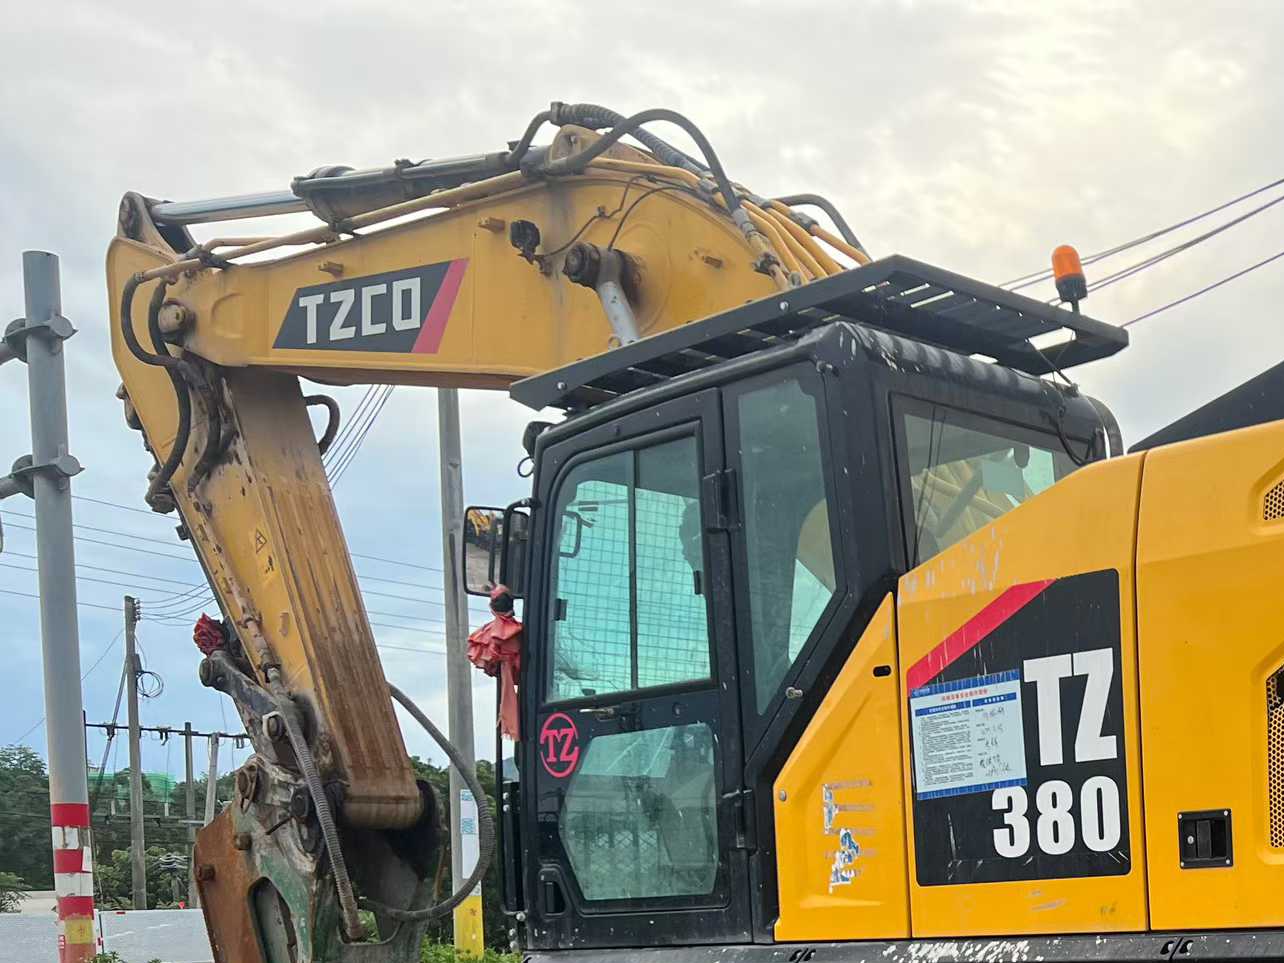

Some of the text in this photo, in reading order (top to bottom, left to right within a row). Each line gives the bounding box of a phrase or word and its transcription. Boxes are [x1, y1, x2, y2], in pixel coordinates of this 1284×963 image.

[299, 277, 421, 345] TZCO
[543, 727, 579, 762] TZ
[1023, 647, 1118, 767] TZ
[991, 775, 1121, 859] 380
